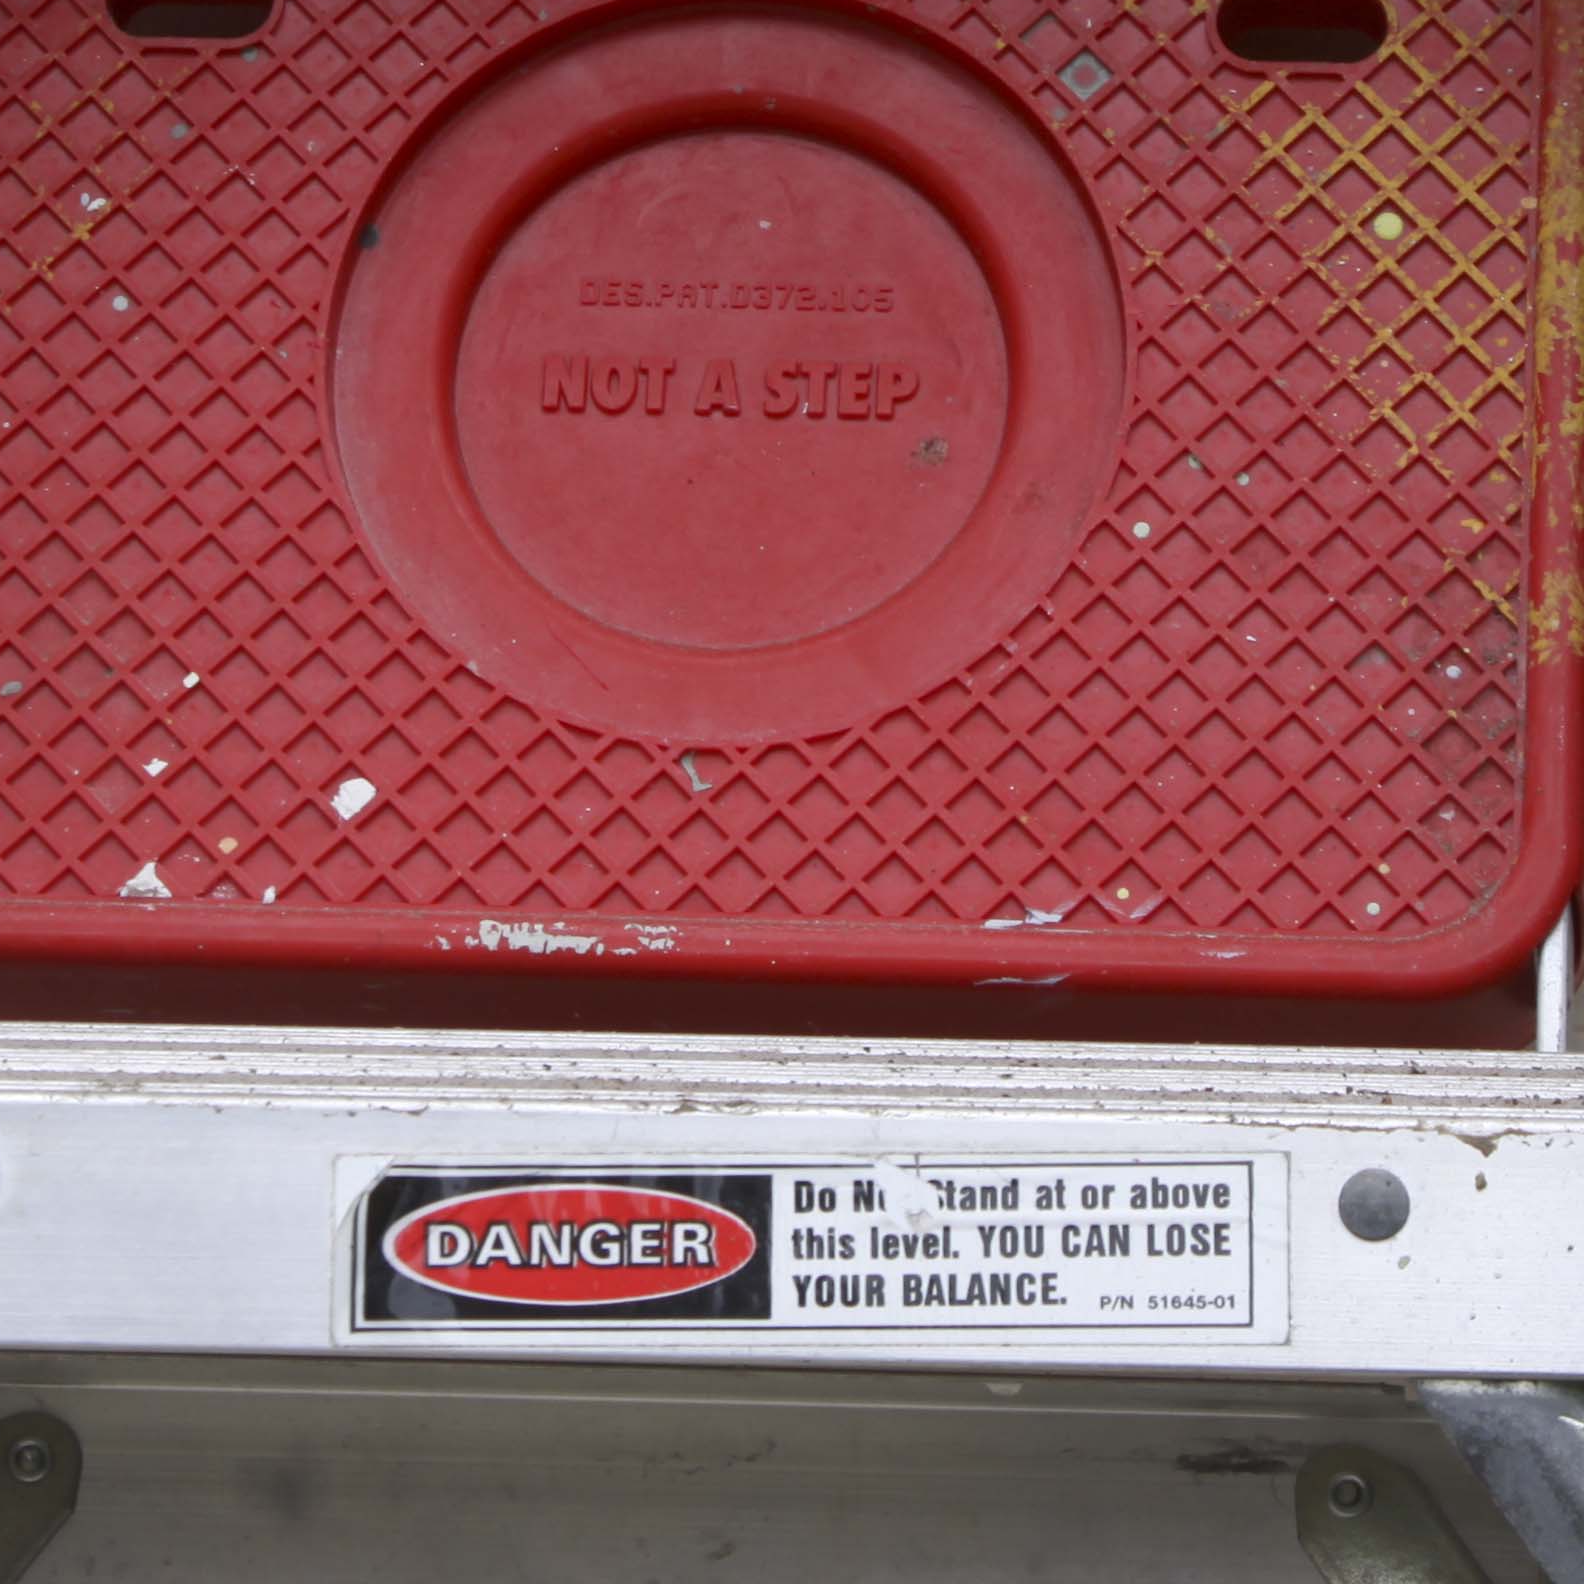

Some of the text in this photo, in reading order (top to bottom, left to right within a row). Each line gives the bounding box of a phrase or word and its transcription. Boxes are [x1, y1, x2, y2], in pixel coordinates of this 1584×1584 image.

[541, 356, 920, 421] NOT A STEP
[793, 1180, 837, 1214] Do
[1035, 1178, 1066, 1211] at
[1081, 1184, 1115, 1210] or
[1129, 1177, 1231, 1210] above
[426, 1220, 716, 1268] DANGER
[791, 1222, 1231, 1260] this level. YOU CAN LOSE
[792, 1272, 1067, 1308] YOUR BALANCE.
[1100, 1295, 1236, 1310] P/N 51645-01
